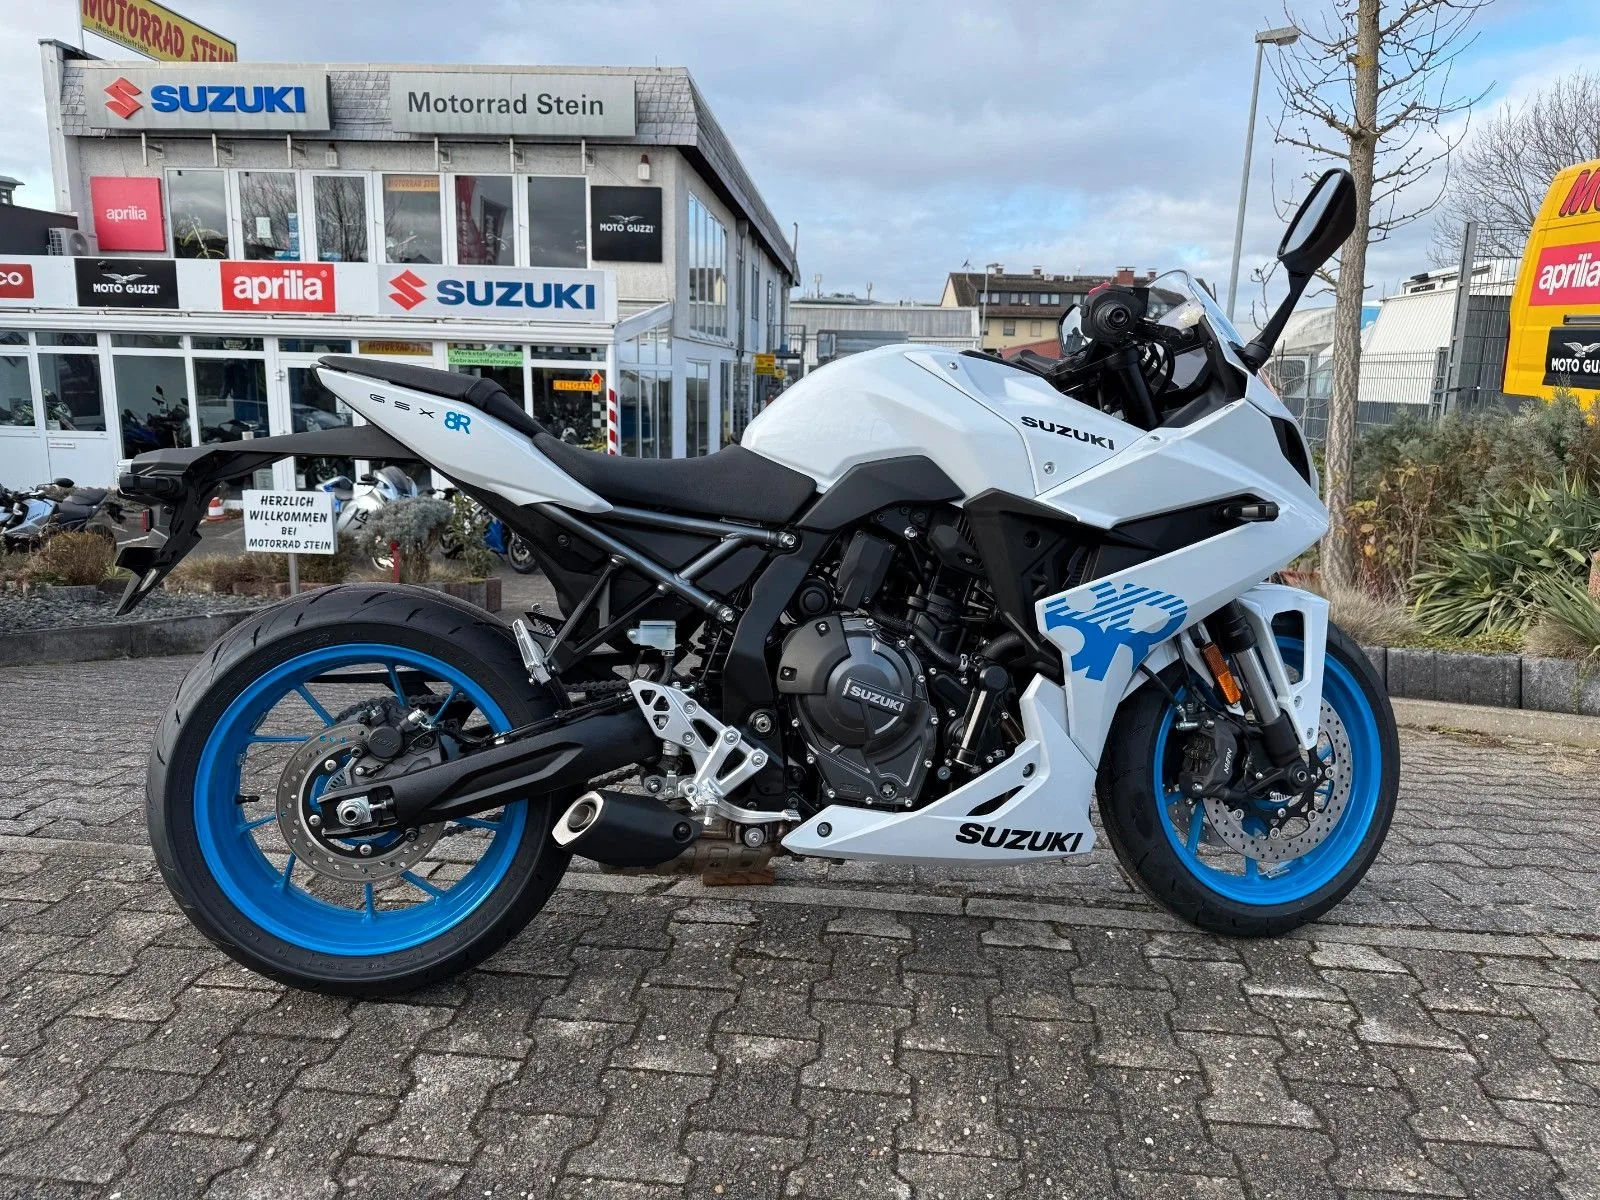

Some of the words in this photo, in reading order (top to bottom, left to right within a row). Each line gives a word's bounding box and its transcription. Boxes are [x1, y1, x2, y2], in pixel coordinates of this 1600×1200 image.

[83, 0, 185, 58] MOTORRAD
[95, 22, 149, 52] Meisterbetrieb
[150, 85, 306, 113] SUZUKI
[407, 91, 528, 115] Motorrad
[536, 93, 604, 116] Stein
[1559, 167, 1600, 217] M
[106, 205, 147, 222] aprilia
[600, 223, 625, 232] MOTO
[626, 224, 654, 233] GUZZI
[233, 269, 323, 304] aprilia
[1538, 252, 1600, 295] aprilia
[93, 283, 123, 293] MOTO
[125, 284, 159, 294] GUZZI
[436, 279, 596, 310] SUZUKI
[1551, 357, 1580, 373] MOTO
[1582, 359, 1600, 374] GU
[1021, 416, 1115, 451] SUZUKI
[260, 495, 314, 507] HERZLICH
[249, 510, 328, 523] WILLKOMMEN
[248, 538, 301, 549] MOTORRAD
[303, 540, 331, 550] STEIN
[281, 526, 297, 535] BEI
[850, 685, 905, 712] SUZUKI
[954, 822, 1084, 853] SUZUKI
